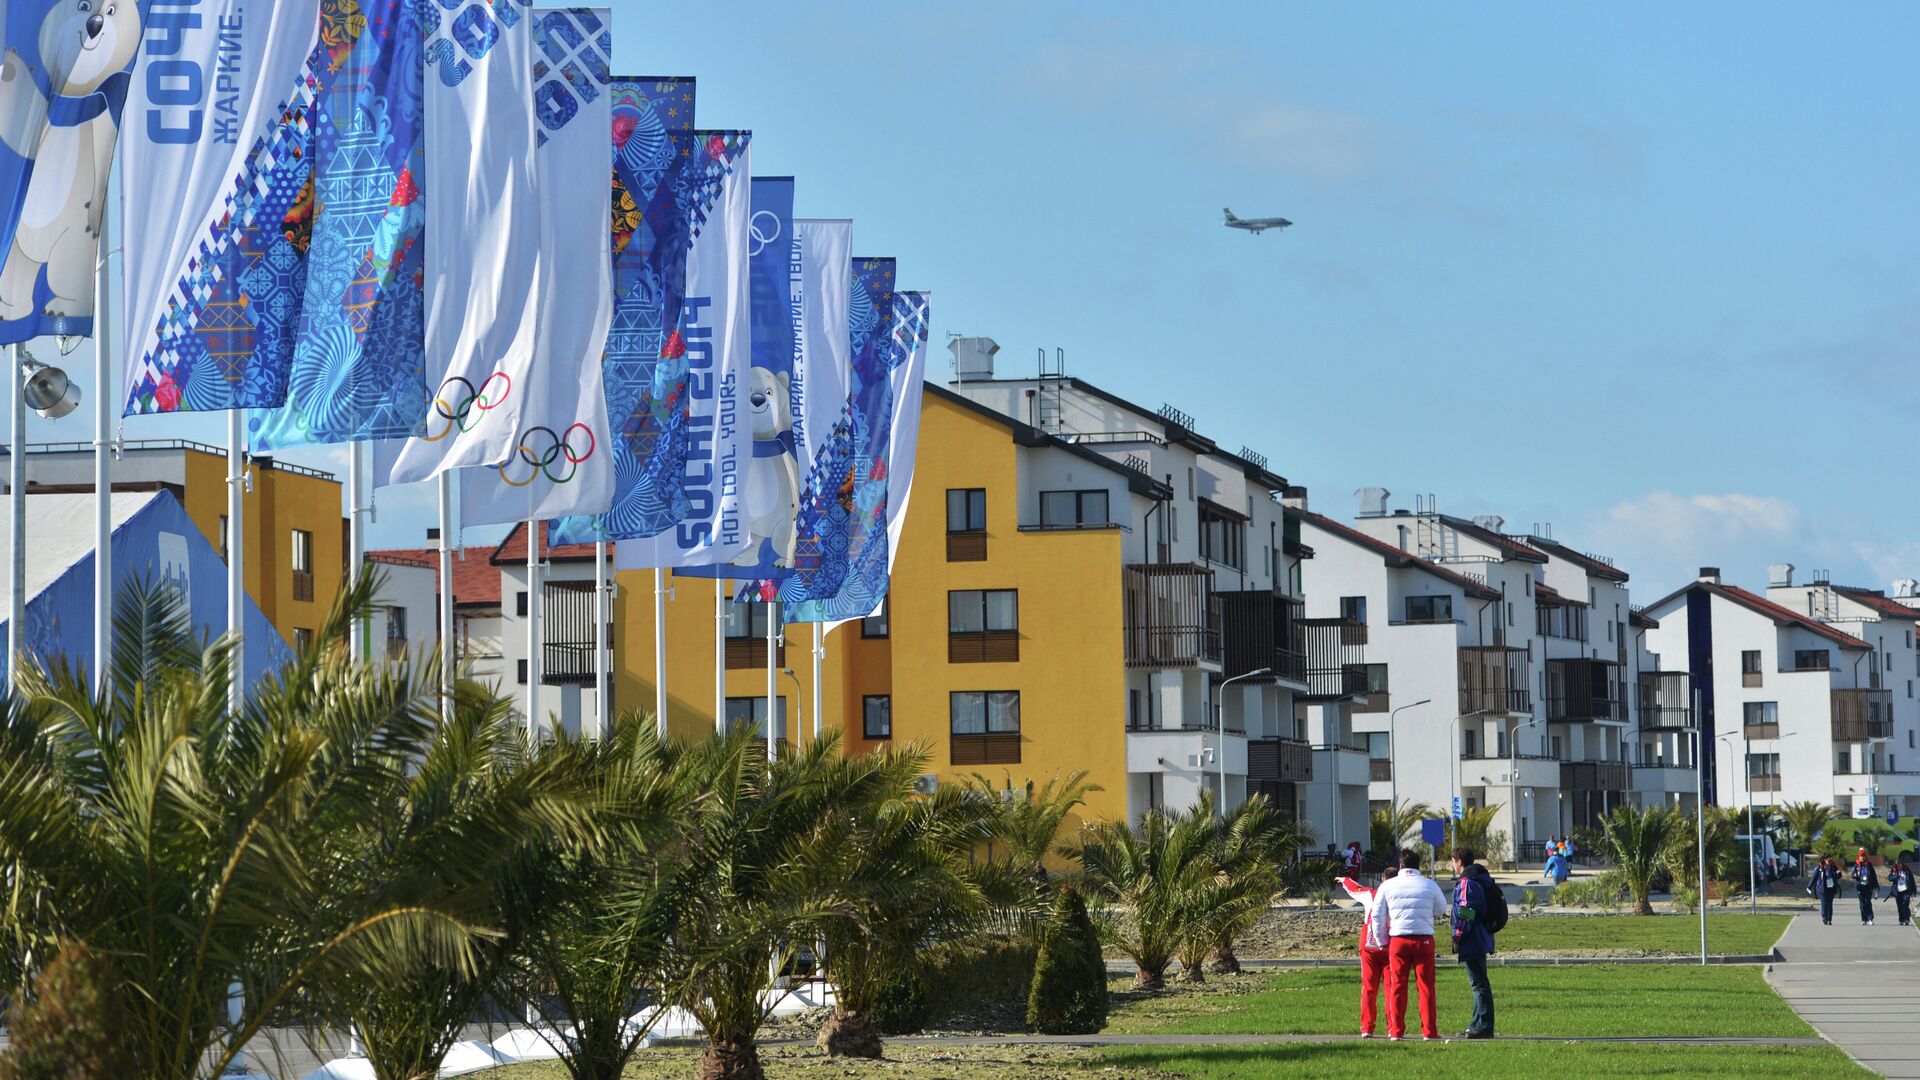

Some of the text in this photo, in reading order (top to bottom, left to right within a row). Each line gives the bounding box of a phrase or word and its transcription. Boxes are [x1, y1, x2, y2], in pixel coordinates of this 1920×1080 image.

[145, 0, 203, 144] СОЧ
[213, 7, 243, 144] ЖАРКИЕ.
[676, 415, 713, 549] SOCHI
[719, 369, 740, 546] HOT. COOL. YOURS.
